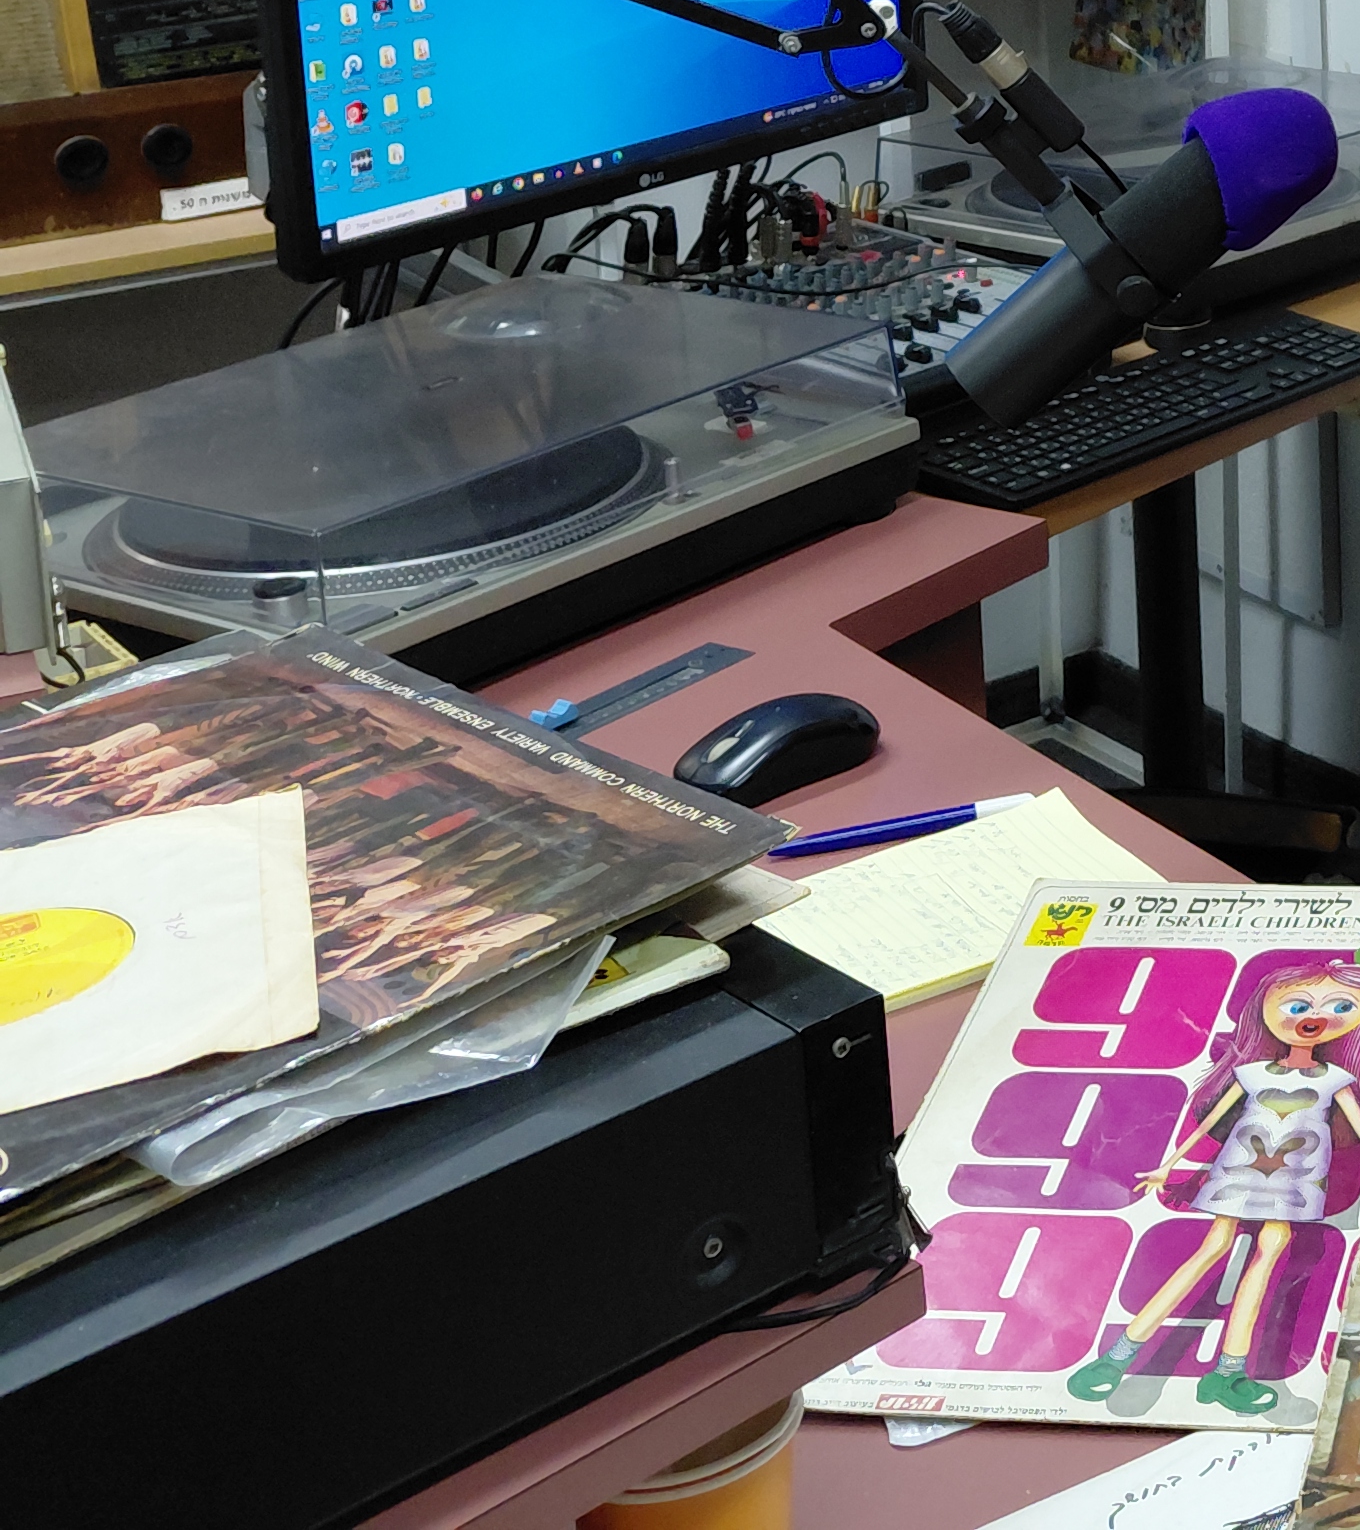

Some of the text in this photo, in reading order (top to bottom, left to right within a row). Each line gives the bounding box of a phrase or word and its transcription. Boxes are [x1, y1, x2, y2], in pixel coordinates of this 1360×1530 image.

[651, 171, 665, 182] LG
[419, 695, 496, 731] ENSEMBLE
[491, 727, 551, 756] VARIETY
[549, 751, 625, 788] COMMAND
[620, 782, 707, 823] NORTHERN
[699, 815, 738, 836] THE
[1107, 896, 1126, 913] 9
[1187, 891, 1265, 915] ילדים
[1273, 892, 1352, 917] לשירי
[1102, 914, 1148, 927] THE
[1156, 915, 1243, 929] ISRAELI
